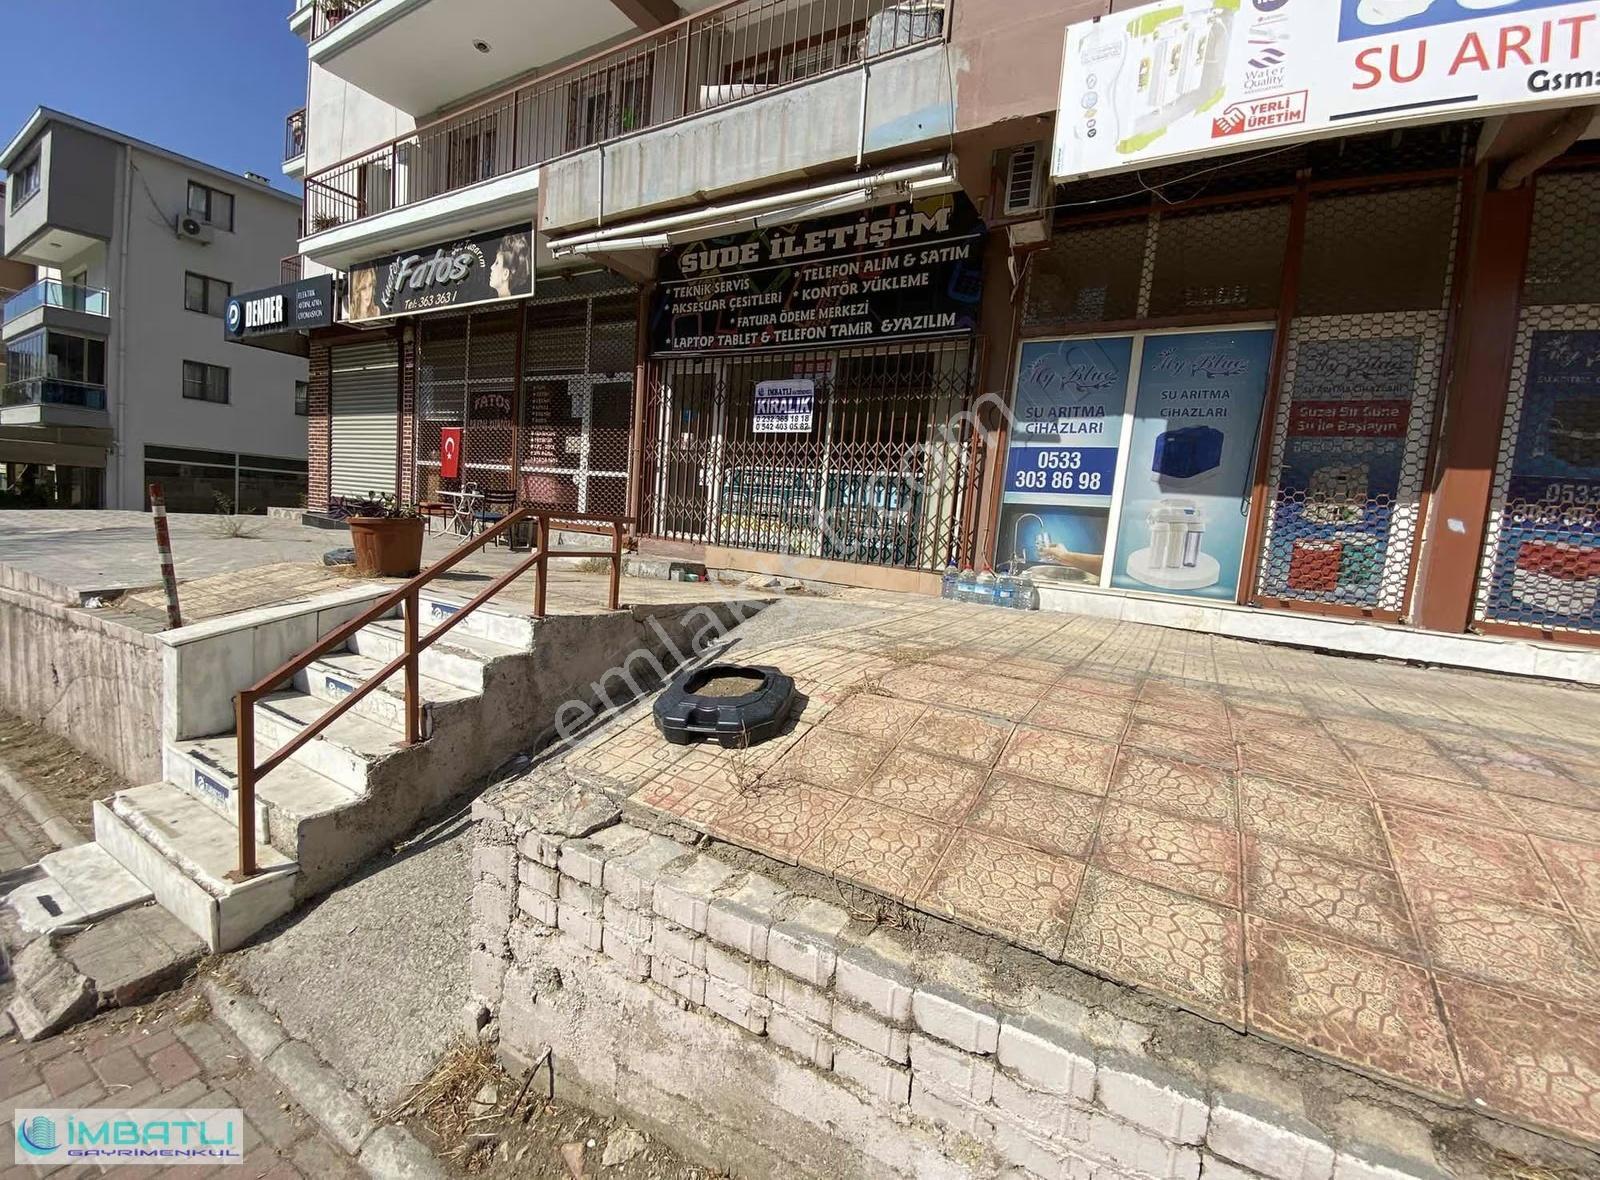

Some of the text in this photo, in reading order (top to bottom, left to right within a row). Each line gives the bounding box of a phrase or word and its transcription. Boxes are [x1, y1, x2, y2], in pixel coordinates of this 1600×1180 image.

[1352, 14, 1597, 90] SU ARIT
[1244, 75, 1284, 90] Quality
[1245, 66, 1285, 81] Water
[1250, 96, 1291, 114] YERLİ
[1248, 109, 1302, 128] ÜRETİM
[681, 207, 951, 273] SUDE İLETİŞİM
[803, 245, 970, 281] TELEFON ALIM & SATIM
[802, 273, 929, 300] KONTÖR YÜKLEME
[245, 294, 283, 328] DENDER
[671, 299, 727, 314] AKSESUAR
[737, 299, 870, 328] FATURA ÖDEME MERKEZİ
[673, 335, 715, 348] LAPTOP
[717, 332, 759, 347] TABLET
[761, 331, 771, 343] &
[773, 326, 826, 342] TELEFON
[1160, 389, 1231, 400] SU ARITMA
[756, 396, 811, 414] KIRALIK
[1025, 405, 1106, 419] SU ARITMA
[1037, 450, 1082, 469] 0533
[1015, 470, 1101, 490] 303 86 98
